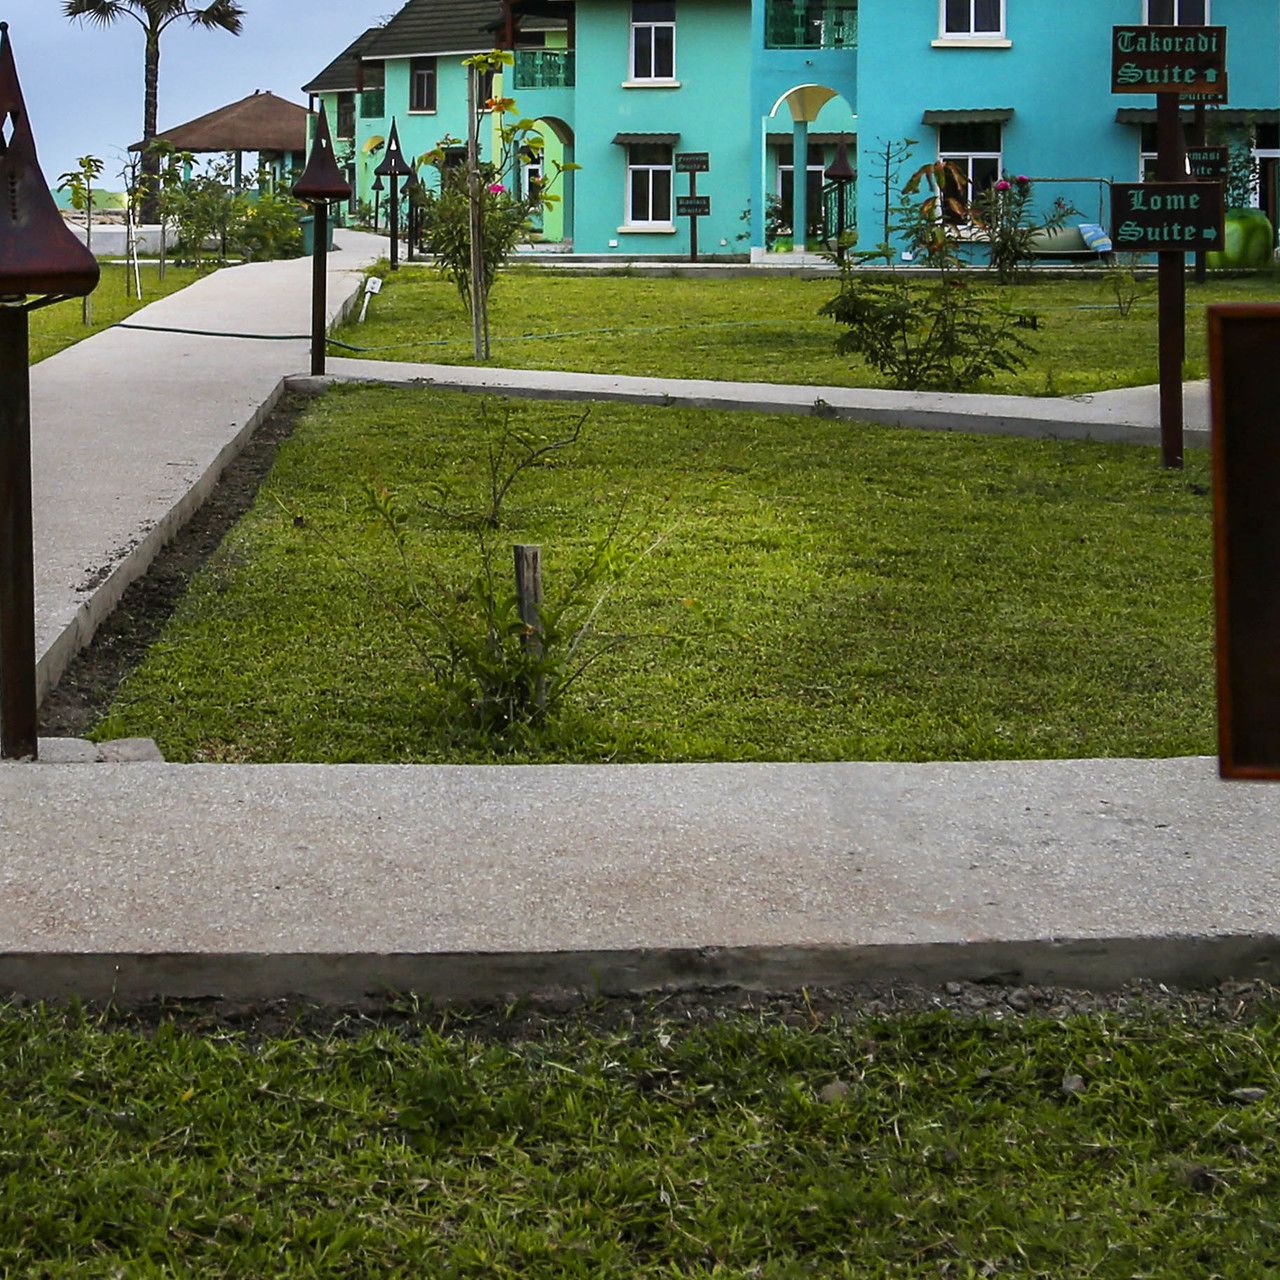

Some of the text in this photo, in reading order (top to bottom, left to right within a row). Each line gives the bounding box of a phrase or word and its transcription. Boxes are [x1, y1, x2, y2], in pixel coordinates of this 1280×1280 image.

[1117, 31, 1218, 52] Takoradi
[1117, 62, 1197, 84] Suite
[1128, 189, 1200, 211] Lome
[1117, 221, 1197, 241] Suite
